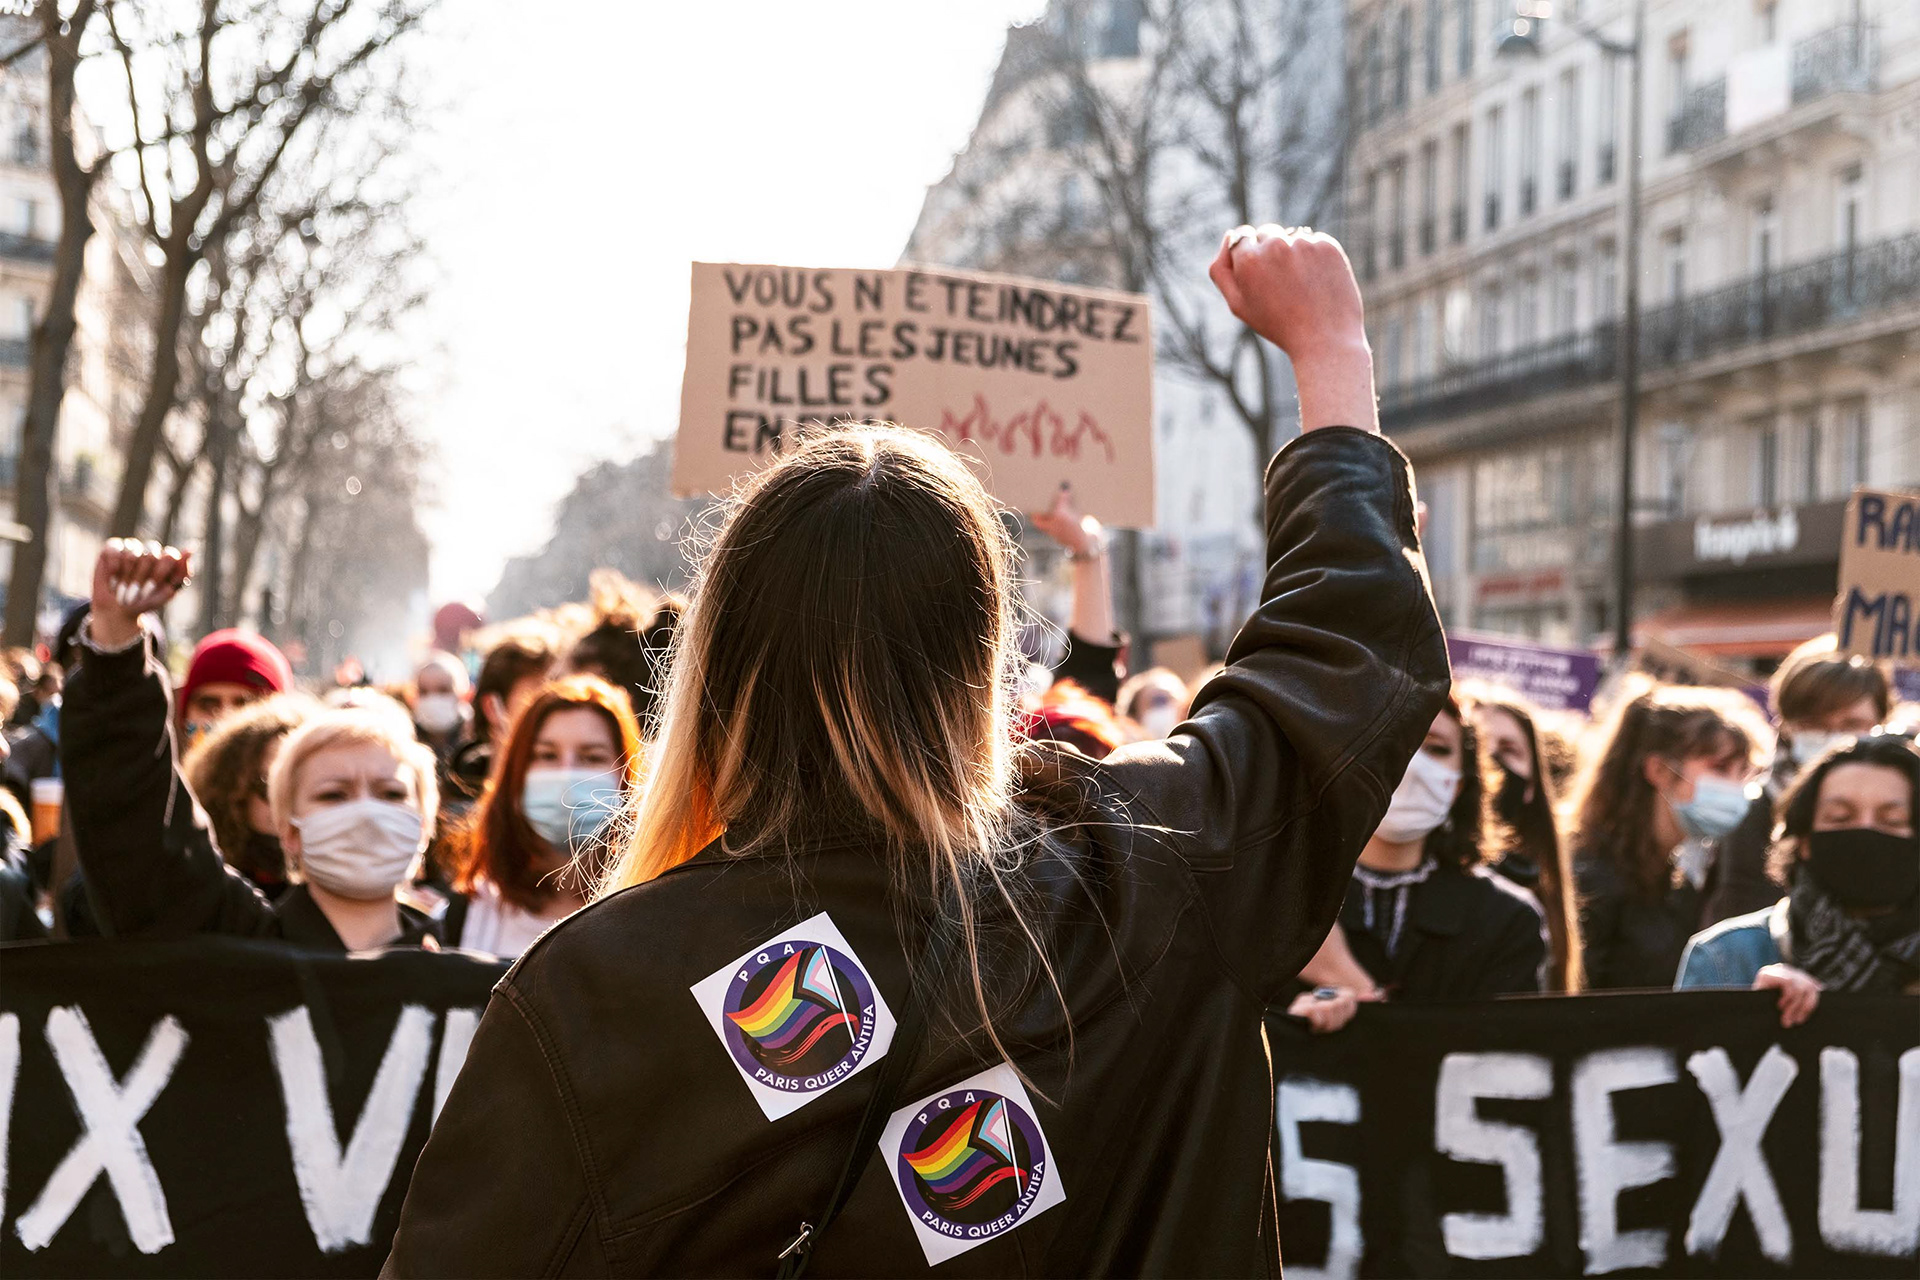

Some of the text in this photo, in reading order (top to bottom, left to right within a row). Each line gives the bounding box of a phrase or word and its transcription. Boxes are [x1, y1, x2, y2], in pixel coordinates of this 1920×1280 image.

[723, 270, 834, 315] VOUS
[731, 316, 1080, 379] PAS LES JEUNES
[728, 363, 893, 407] FILLES
[754, 1003, 874, 1090] PARIS QUEER ANTIFA
[921, 1161, 1044, 1238] PARIS QUEER ANTIFA
